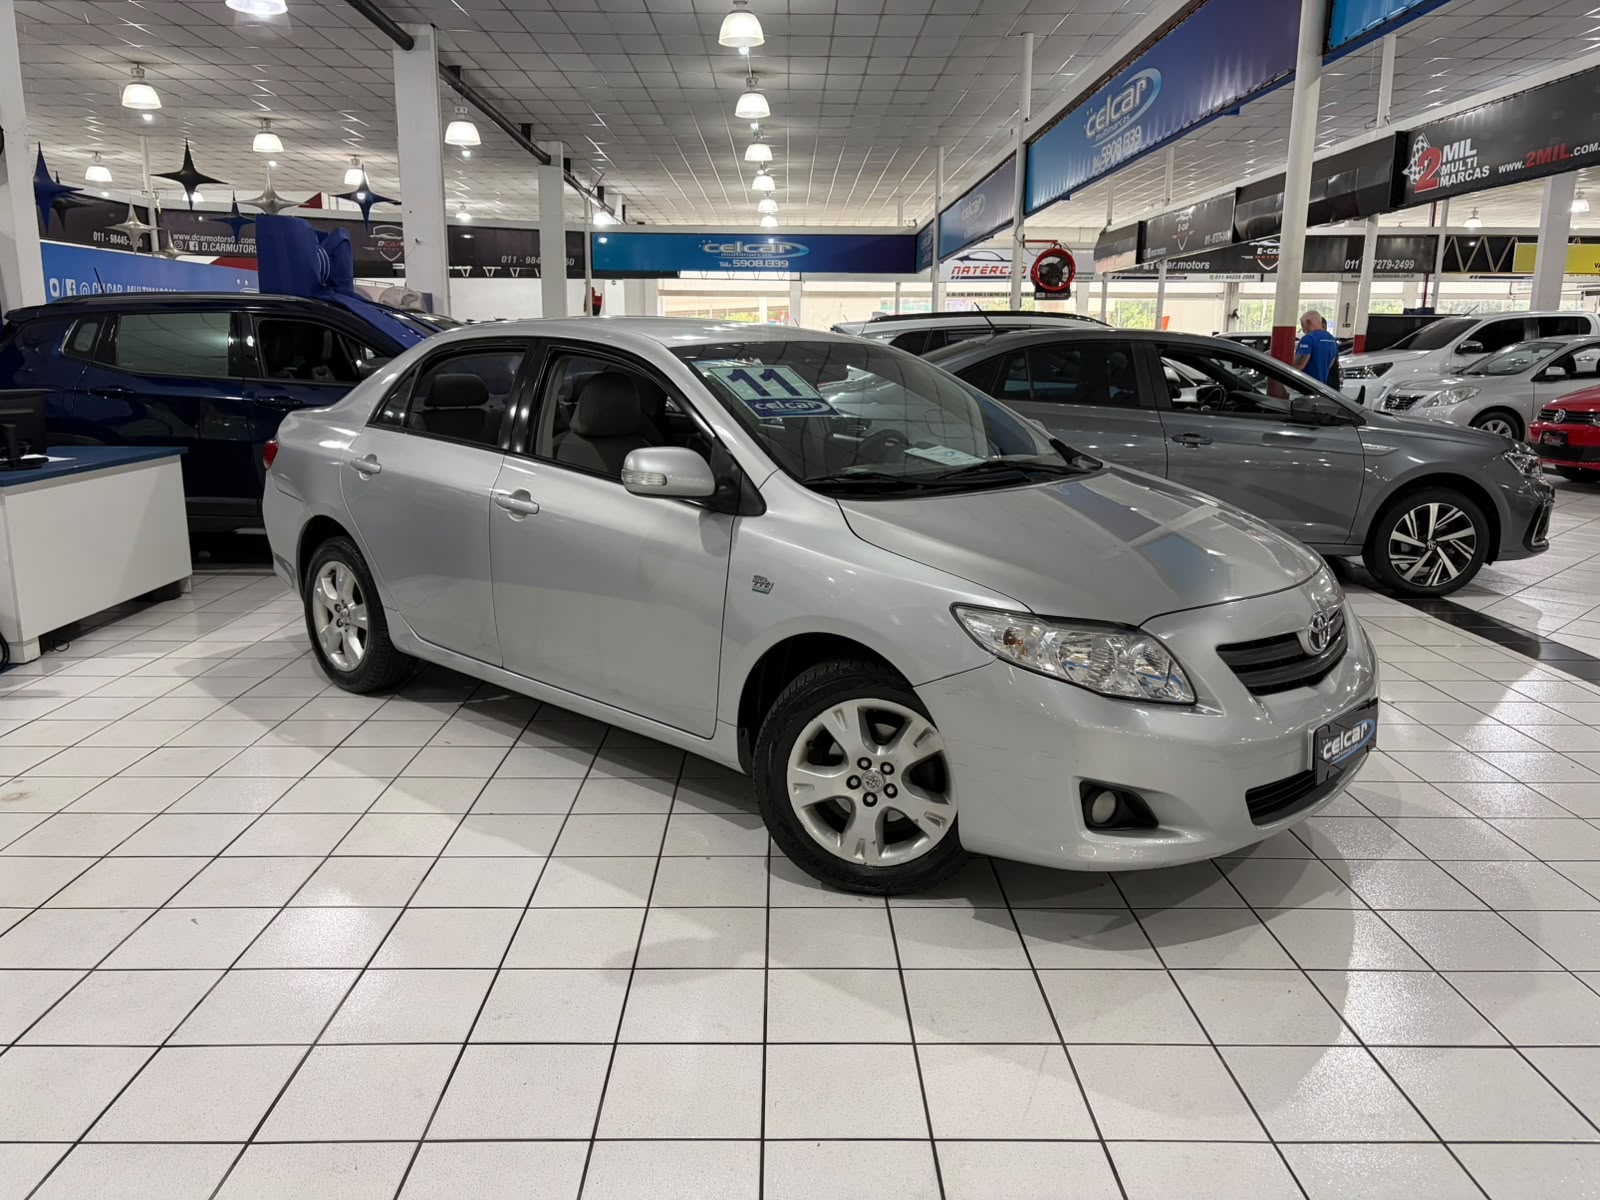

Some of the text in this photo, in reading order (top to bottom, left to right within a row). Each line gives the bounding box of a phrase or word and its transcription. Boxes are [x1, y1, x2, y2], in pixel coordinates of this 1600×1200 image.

[1086, 76, 1148, 138] celcar
[1413, 138, 1478, 194] 2 MIL
[1441, 156, 1478, 174] MULTI
[1440, 165, 1490, 188] MARCAS
[93, 231, 105, 242] 011
[703, 241, 793, 254] celcar
[501, 255, 517, 264] 011
[1345, 259, 1360, 270] 011
[727, 369, 803, 396] 11
[754, 400, 819, 410] celcar
[1323, 721, 1367, 761] celcar
